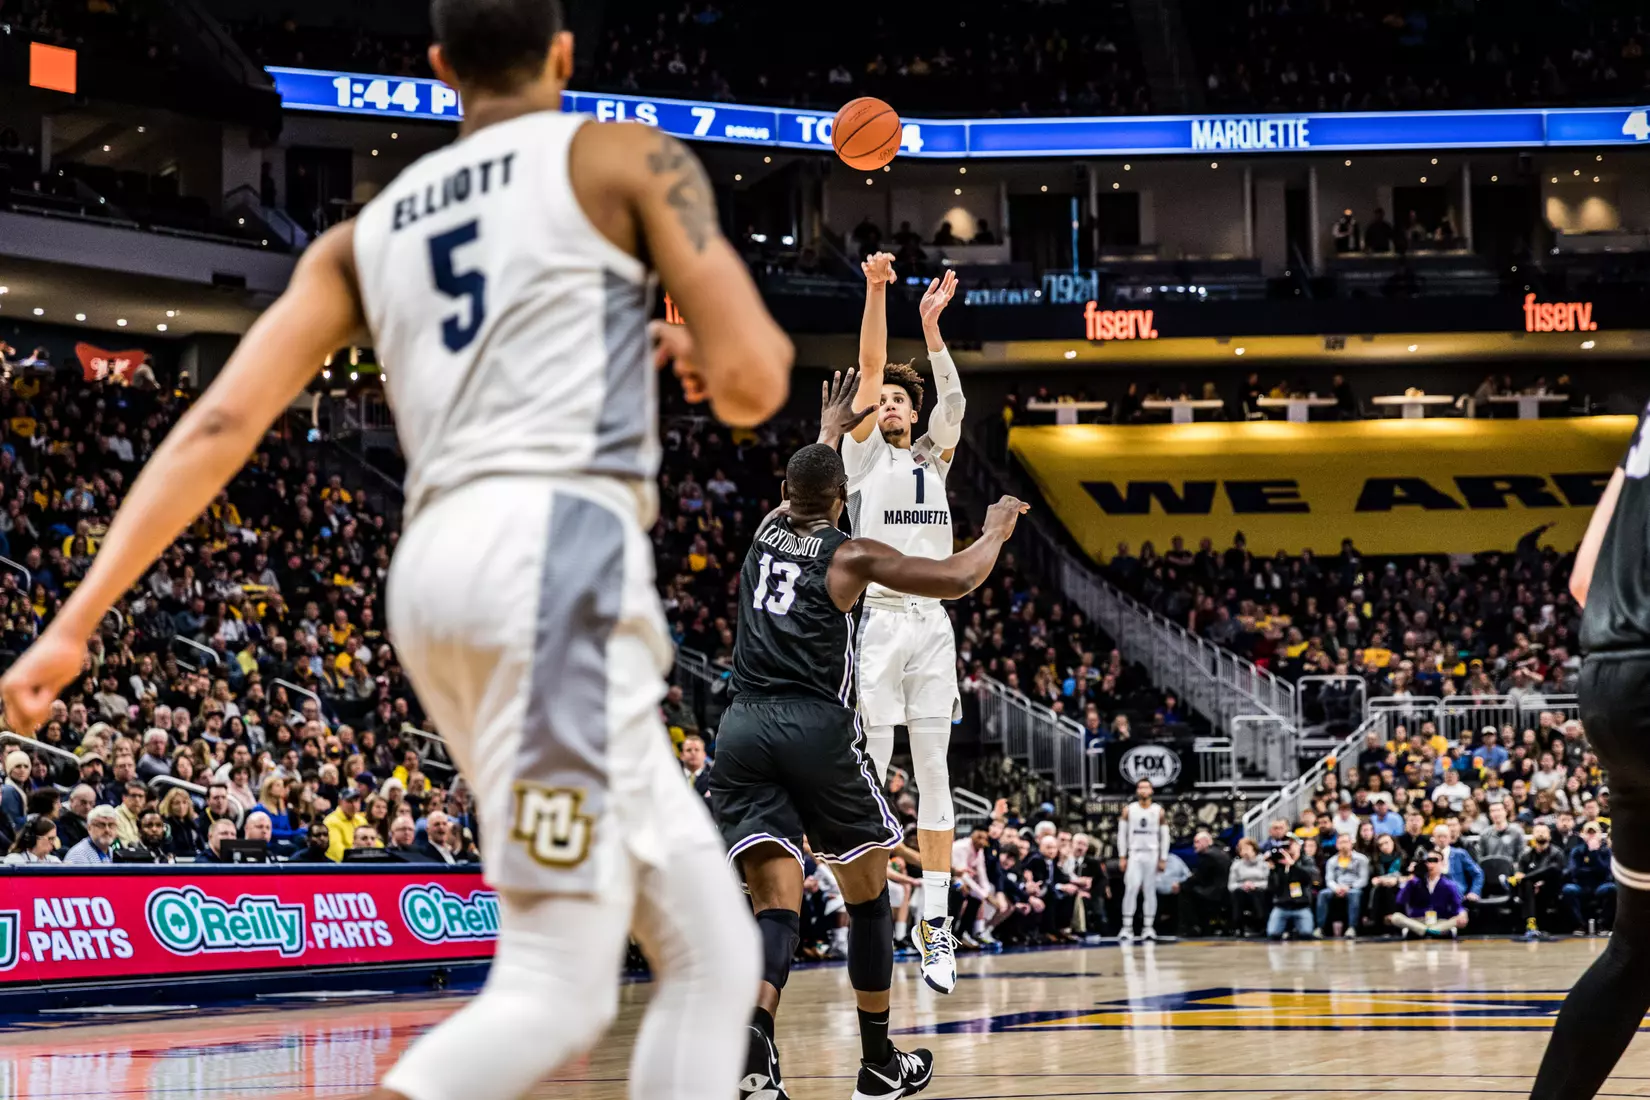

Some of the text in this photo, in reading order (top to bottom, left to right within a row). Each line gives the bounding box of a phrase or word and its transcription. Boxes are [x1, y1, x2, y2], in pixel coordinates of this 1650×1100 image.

[332, 77, 464, 115] 1:44 P
[691, 107, 716, 136] 7
[1191, 119, 1310, 150] MARQUETTE
[901, 124, 924, 153] 4
[392, 151, 516, 232] ELLIOTT
[427, 217, 486, 354] 5
[912, 468, 925, 504] 1
[1080, 480, 1311, 514] WE
[884, 510, 948, 525] MARQUETTE
[753, 552, 802, 615] 13
[1134, 755, 1166, 771] FOX
[34, 896, 116, 928] AUTO
[154, 894, 298, 948] O'Reilly
[313, 892, 378, 921] AUTO
[27, 927, 134, 962] PARTS
[310, 920, 393, 949] PARTS
